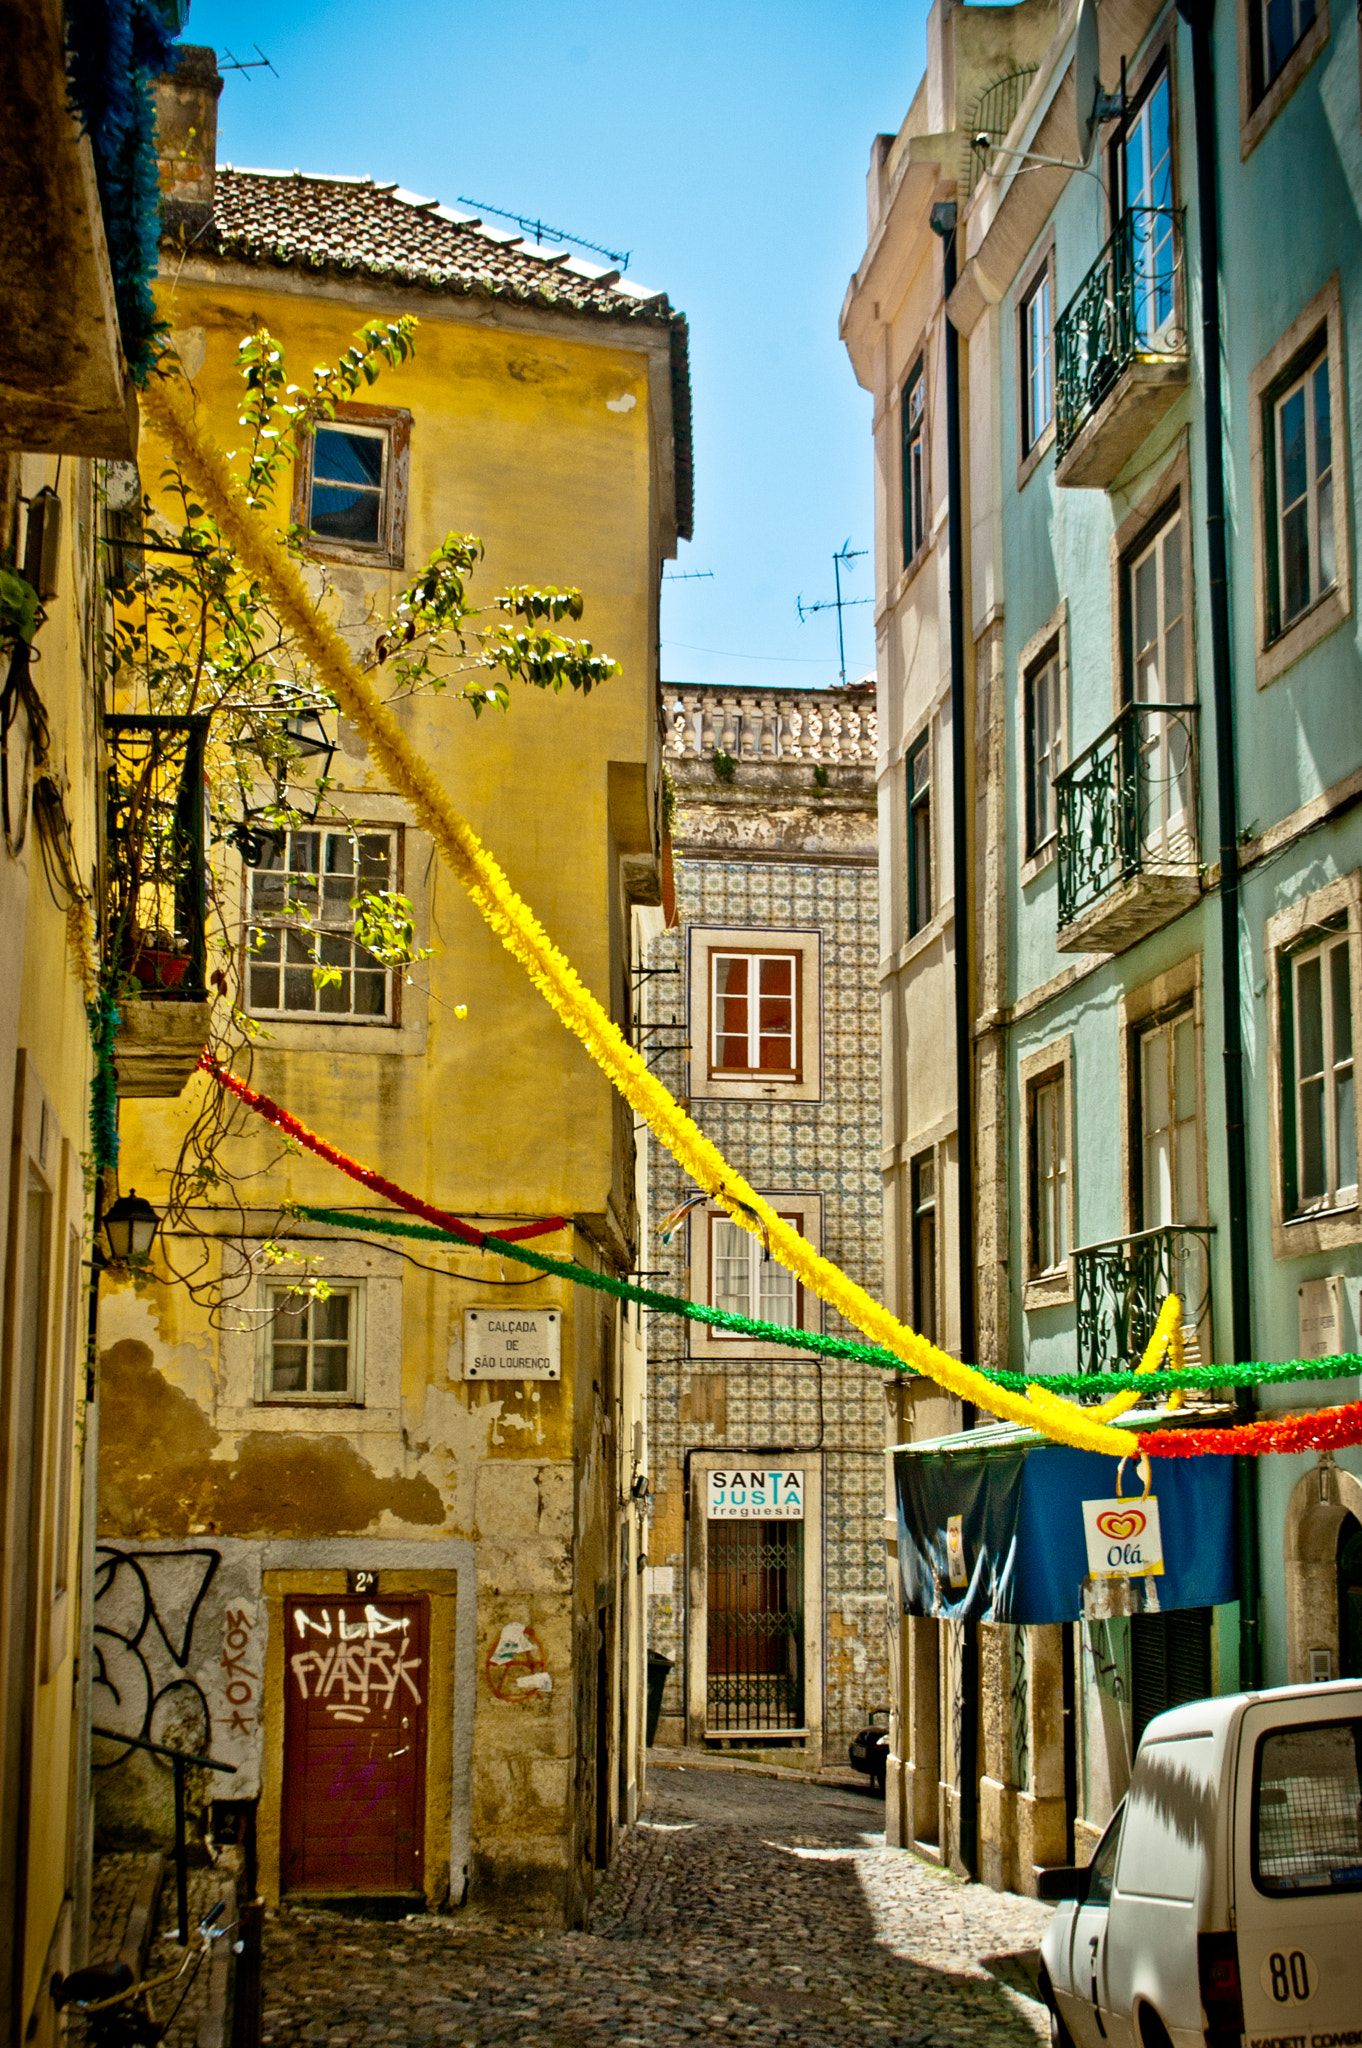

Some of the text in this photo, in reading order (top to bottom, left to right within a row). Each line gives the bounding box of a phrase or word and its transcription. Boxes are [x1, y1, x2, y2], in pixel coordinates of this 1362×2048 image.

[488, 1321, 537, 1334] CALÇADA
[506, 1340, 519, 1351] DE
[474, 1355, 551, 1370] SÃO LOURENÇO
[712, 1472, 801, 1488] SANTA
[713, 1491, 801, 1505] JUSTA
[712, 1506, 801, 1517] freguesia
[1107, 1543, 1143, 1567] Olá
[1269, 1950, 1310, 2003] 80
